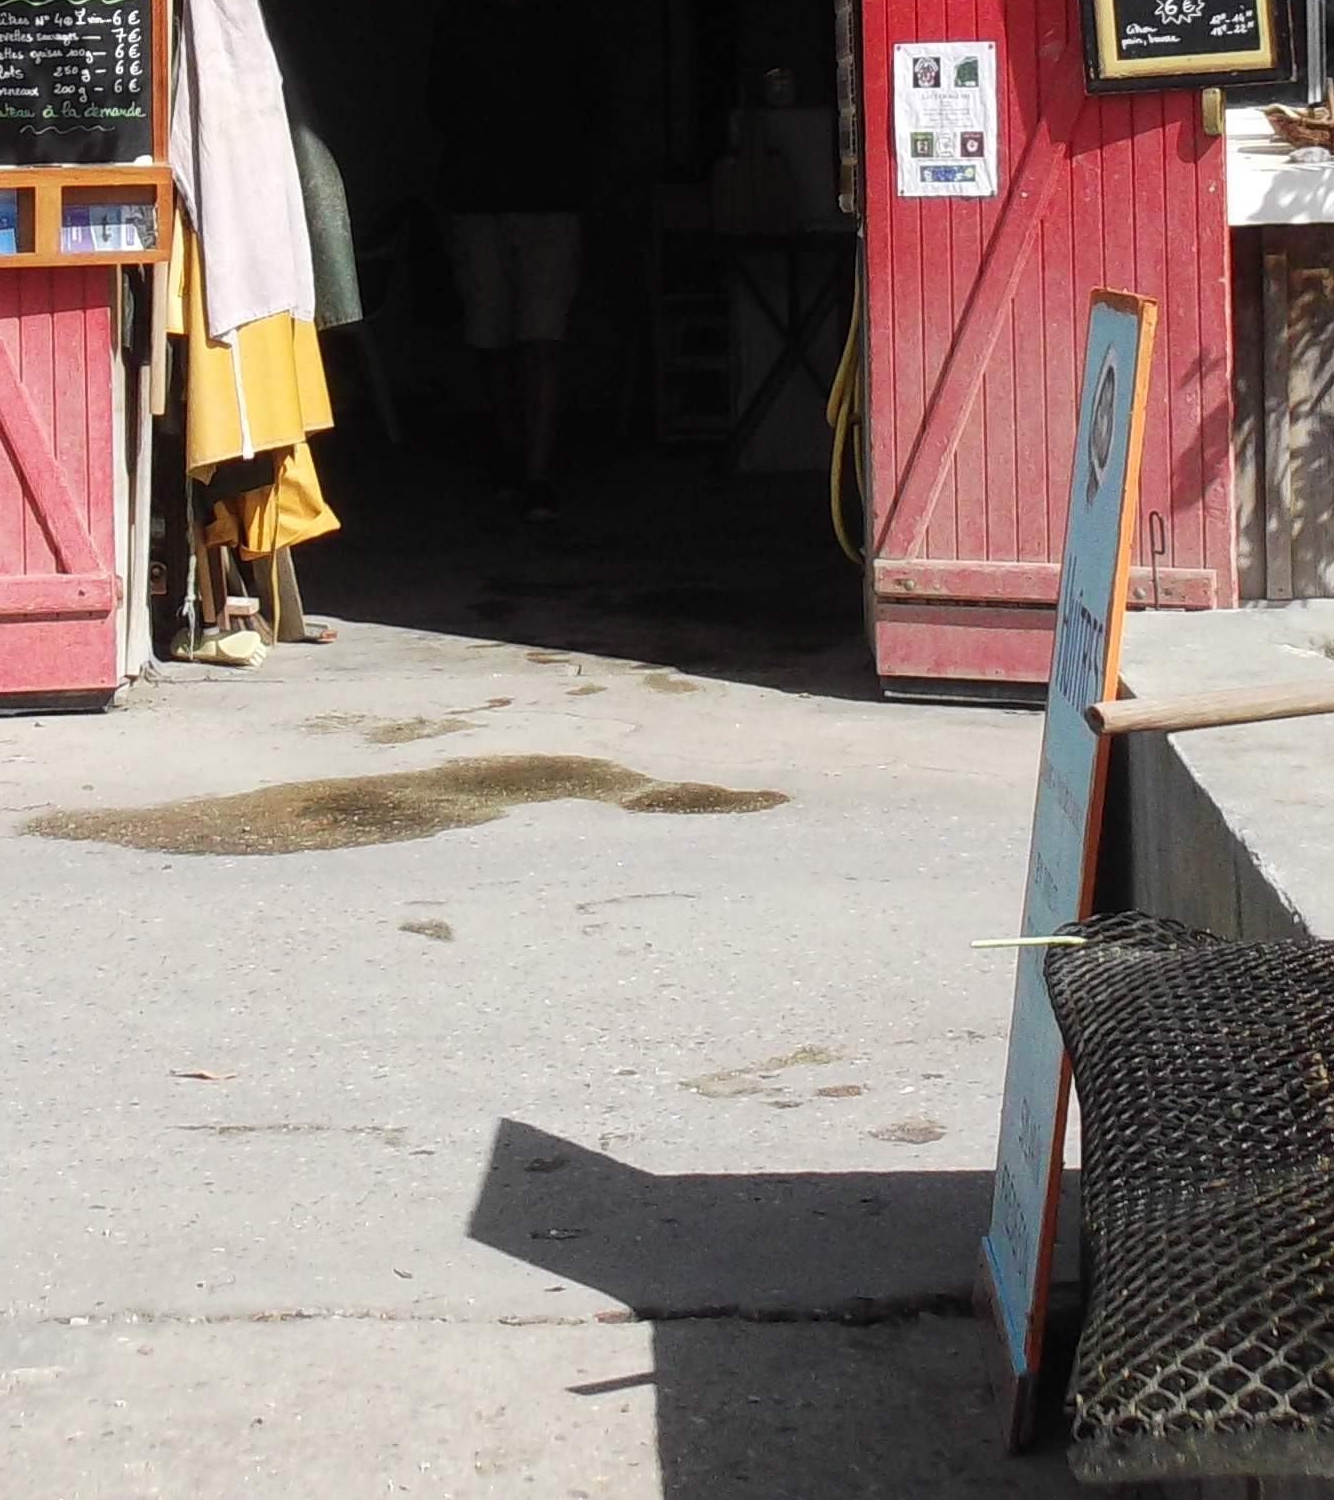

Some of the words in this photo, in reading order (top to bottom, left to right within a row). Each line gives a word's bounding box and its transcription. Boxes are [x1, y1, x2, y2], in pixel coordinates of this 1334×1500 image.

[111, 28, 127, 43] 7
[114, 43, 124, 58] 6
[115, 60, 124, 75] 6
[53, 84, 76, 95] 200
[114, 78, 123, 93] 6
[62, 101, 81, 118] la
[84, 101, 147, 119] demande
